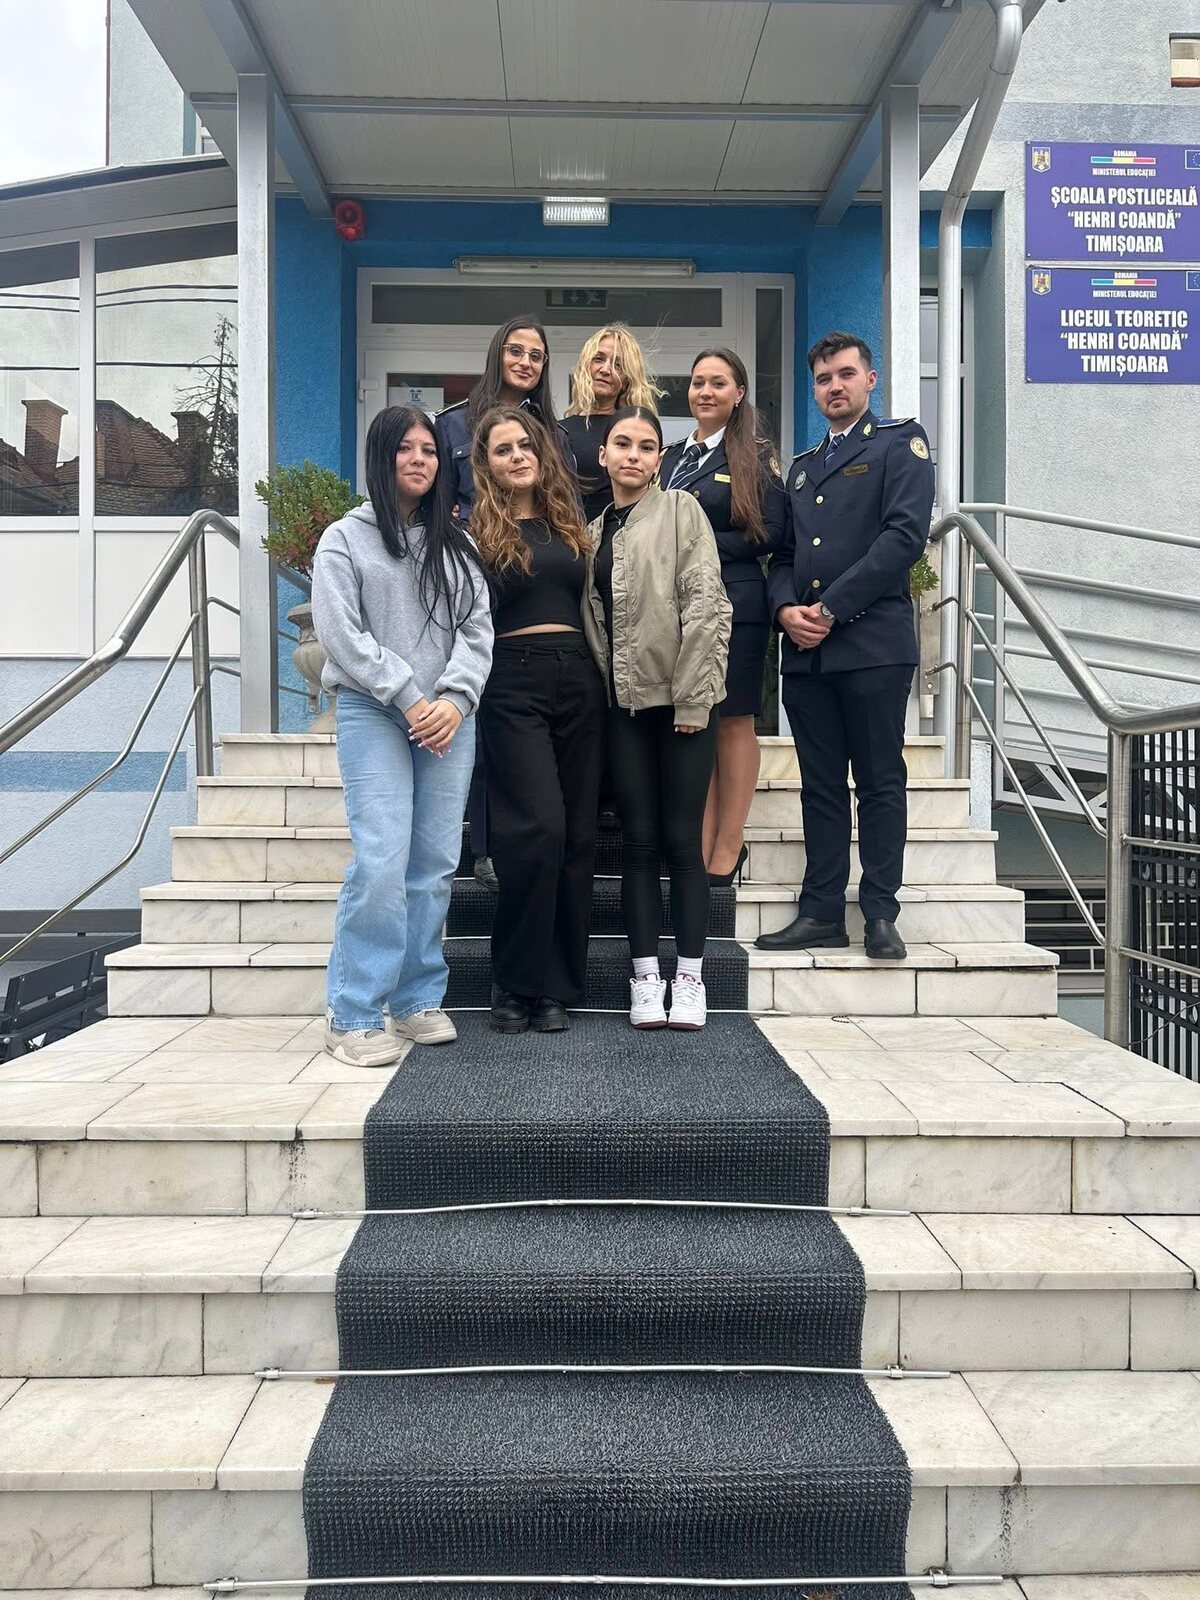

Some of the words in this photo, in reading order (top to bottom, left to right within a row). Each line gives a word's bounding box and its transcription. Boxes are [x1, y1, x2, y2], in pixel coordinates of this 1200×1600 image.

[1092, 168, 1126, 176] MINISTERUL
[1051, 186, 1105, 208] ȘCOALA
[1108, 185, 1198, 206] POSTLICEALĂ
[1086, 235, 1164, 257] TIMIȘOARA
[1093, 290, 1127, 298] MINISTERUL
[1060, 309, 1112, 327] LICEUL
[1115, 310, 1188, 328] TEORETIC
[1081, 355, 1169, 377] TIMIȘOARA
